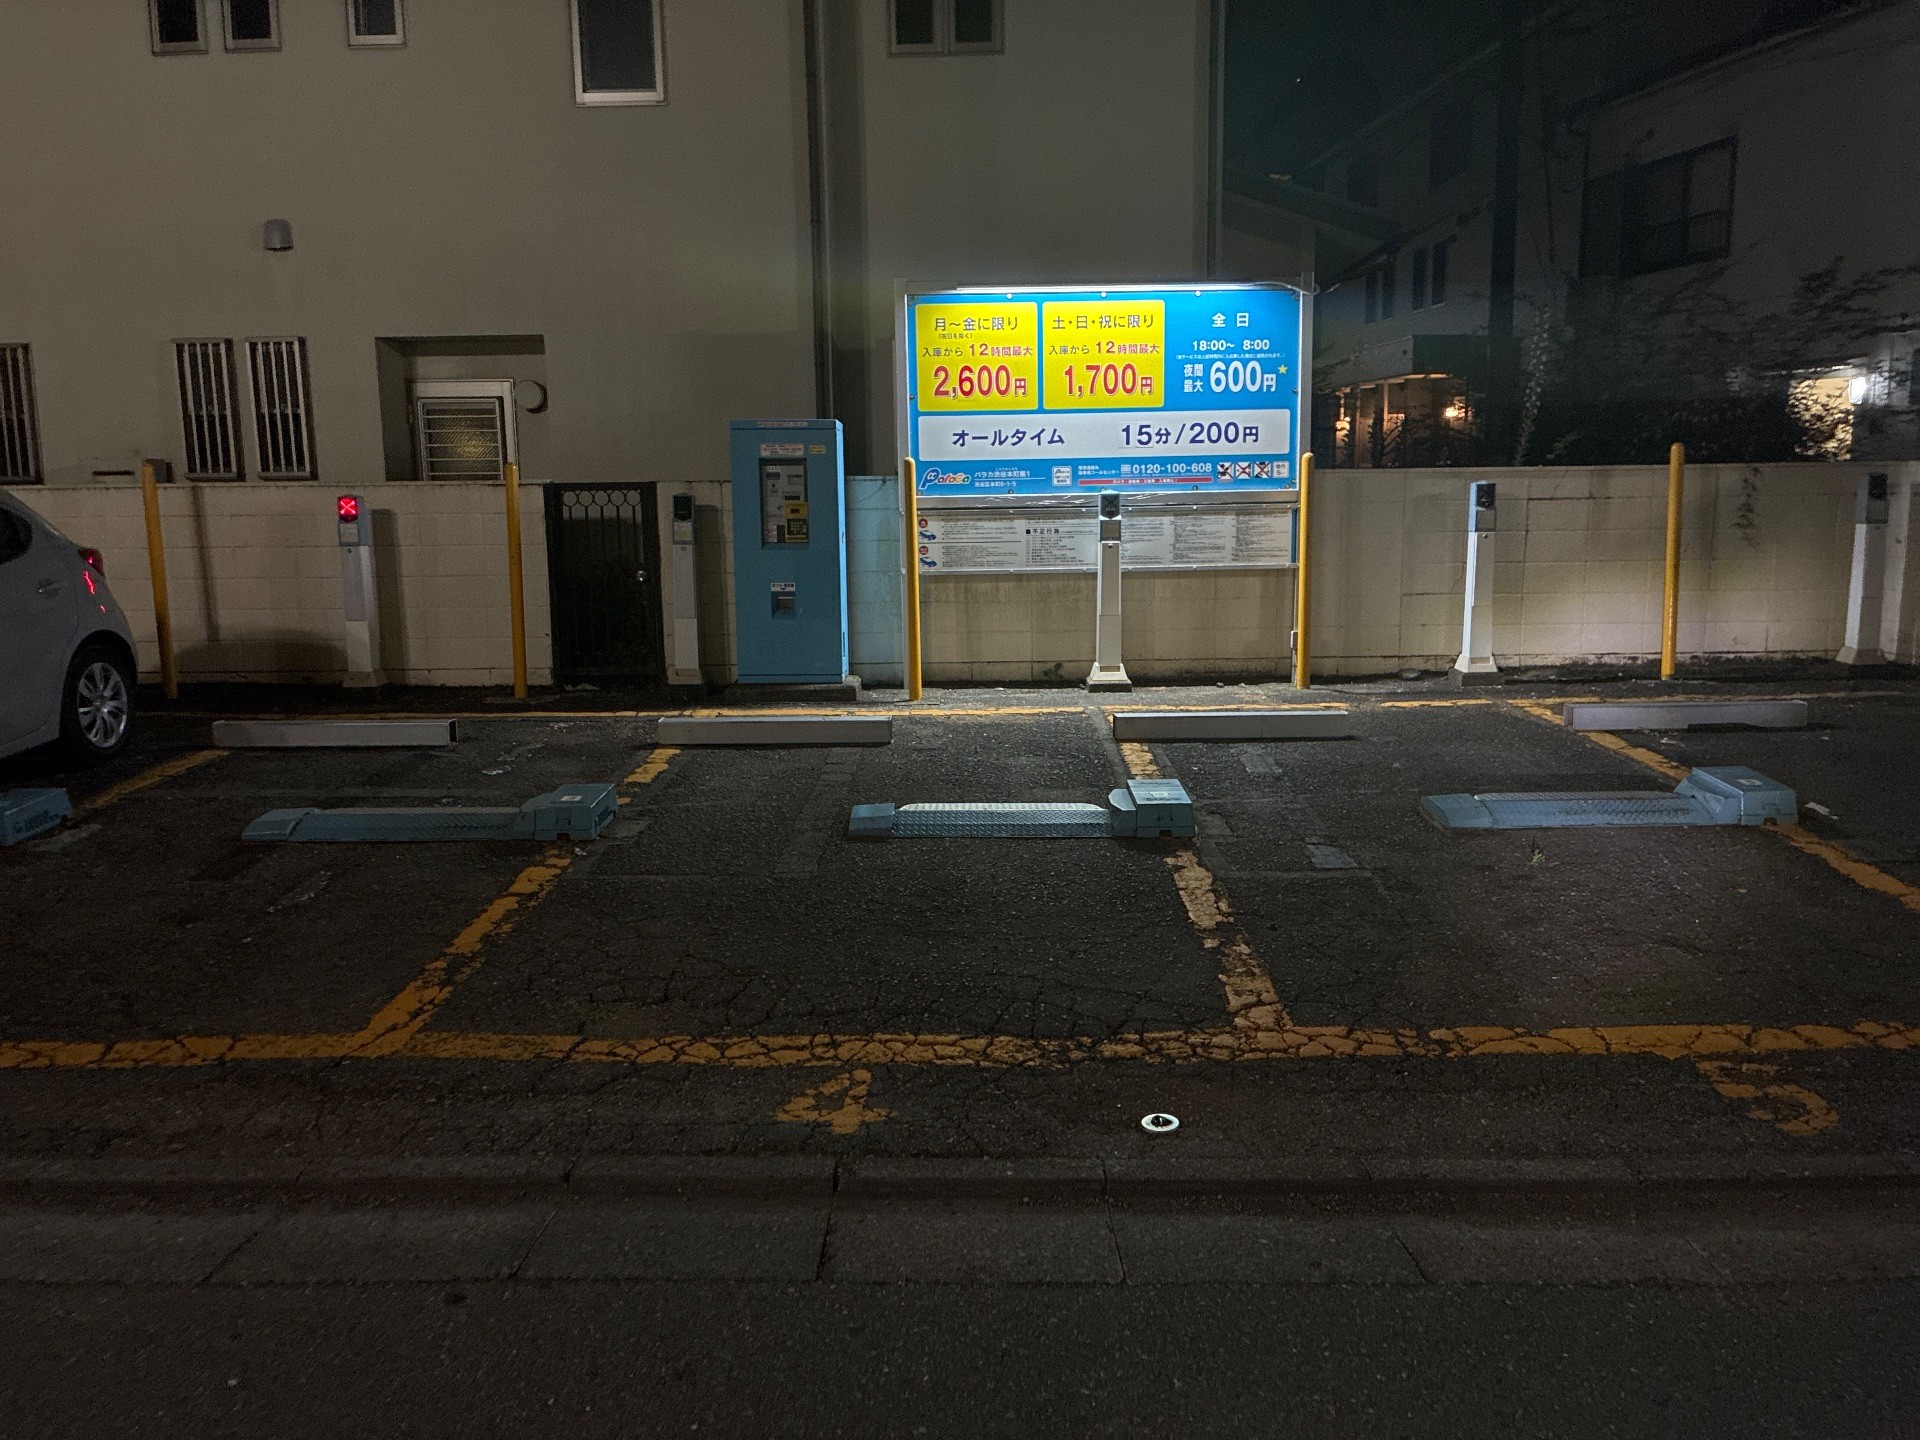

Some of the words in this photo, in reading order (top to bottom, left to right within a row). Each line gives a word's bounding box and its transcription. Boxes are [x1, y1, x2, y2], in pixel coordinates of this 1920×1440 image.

[934, 316, 1019, 332] 月～金に限り
[1052, 314, 1155, 330] 土・日・祝に限り
[1242, 339, 1270, 351] 8:00
[1183, 363, 1204, 377] 夜間
[1209, 360, 1277, 393] 600円
[933, 364, 1027, 399] 2,600円
[1063, 363, 1155, 398] 1,700円
[1183, 379, 1204, 393] 最大
[952, 428, 1066, 447] オールタイム
[1121, 421, 1259, 446] 15分/200円
[1132, 463, 1212, 474] 0120-100-608
[774, 1068, 899, 1135] 4
[1695, 1060, 1840, 1135] 5
